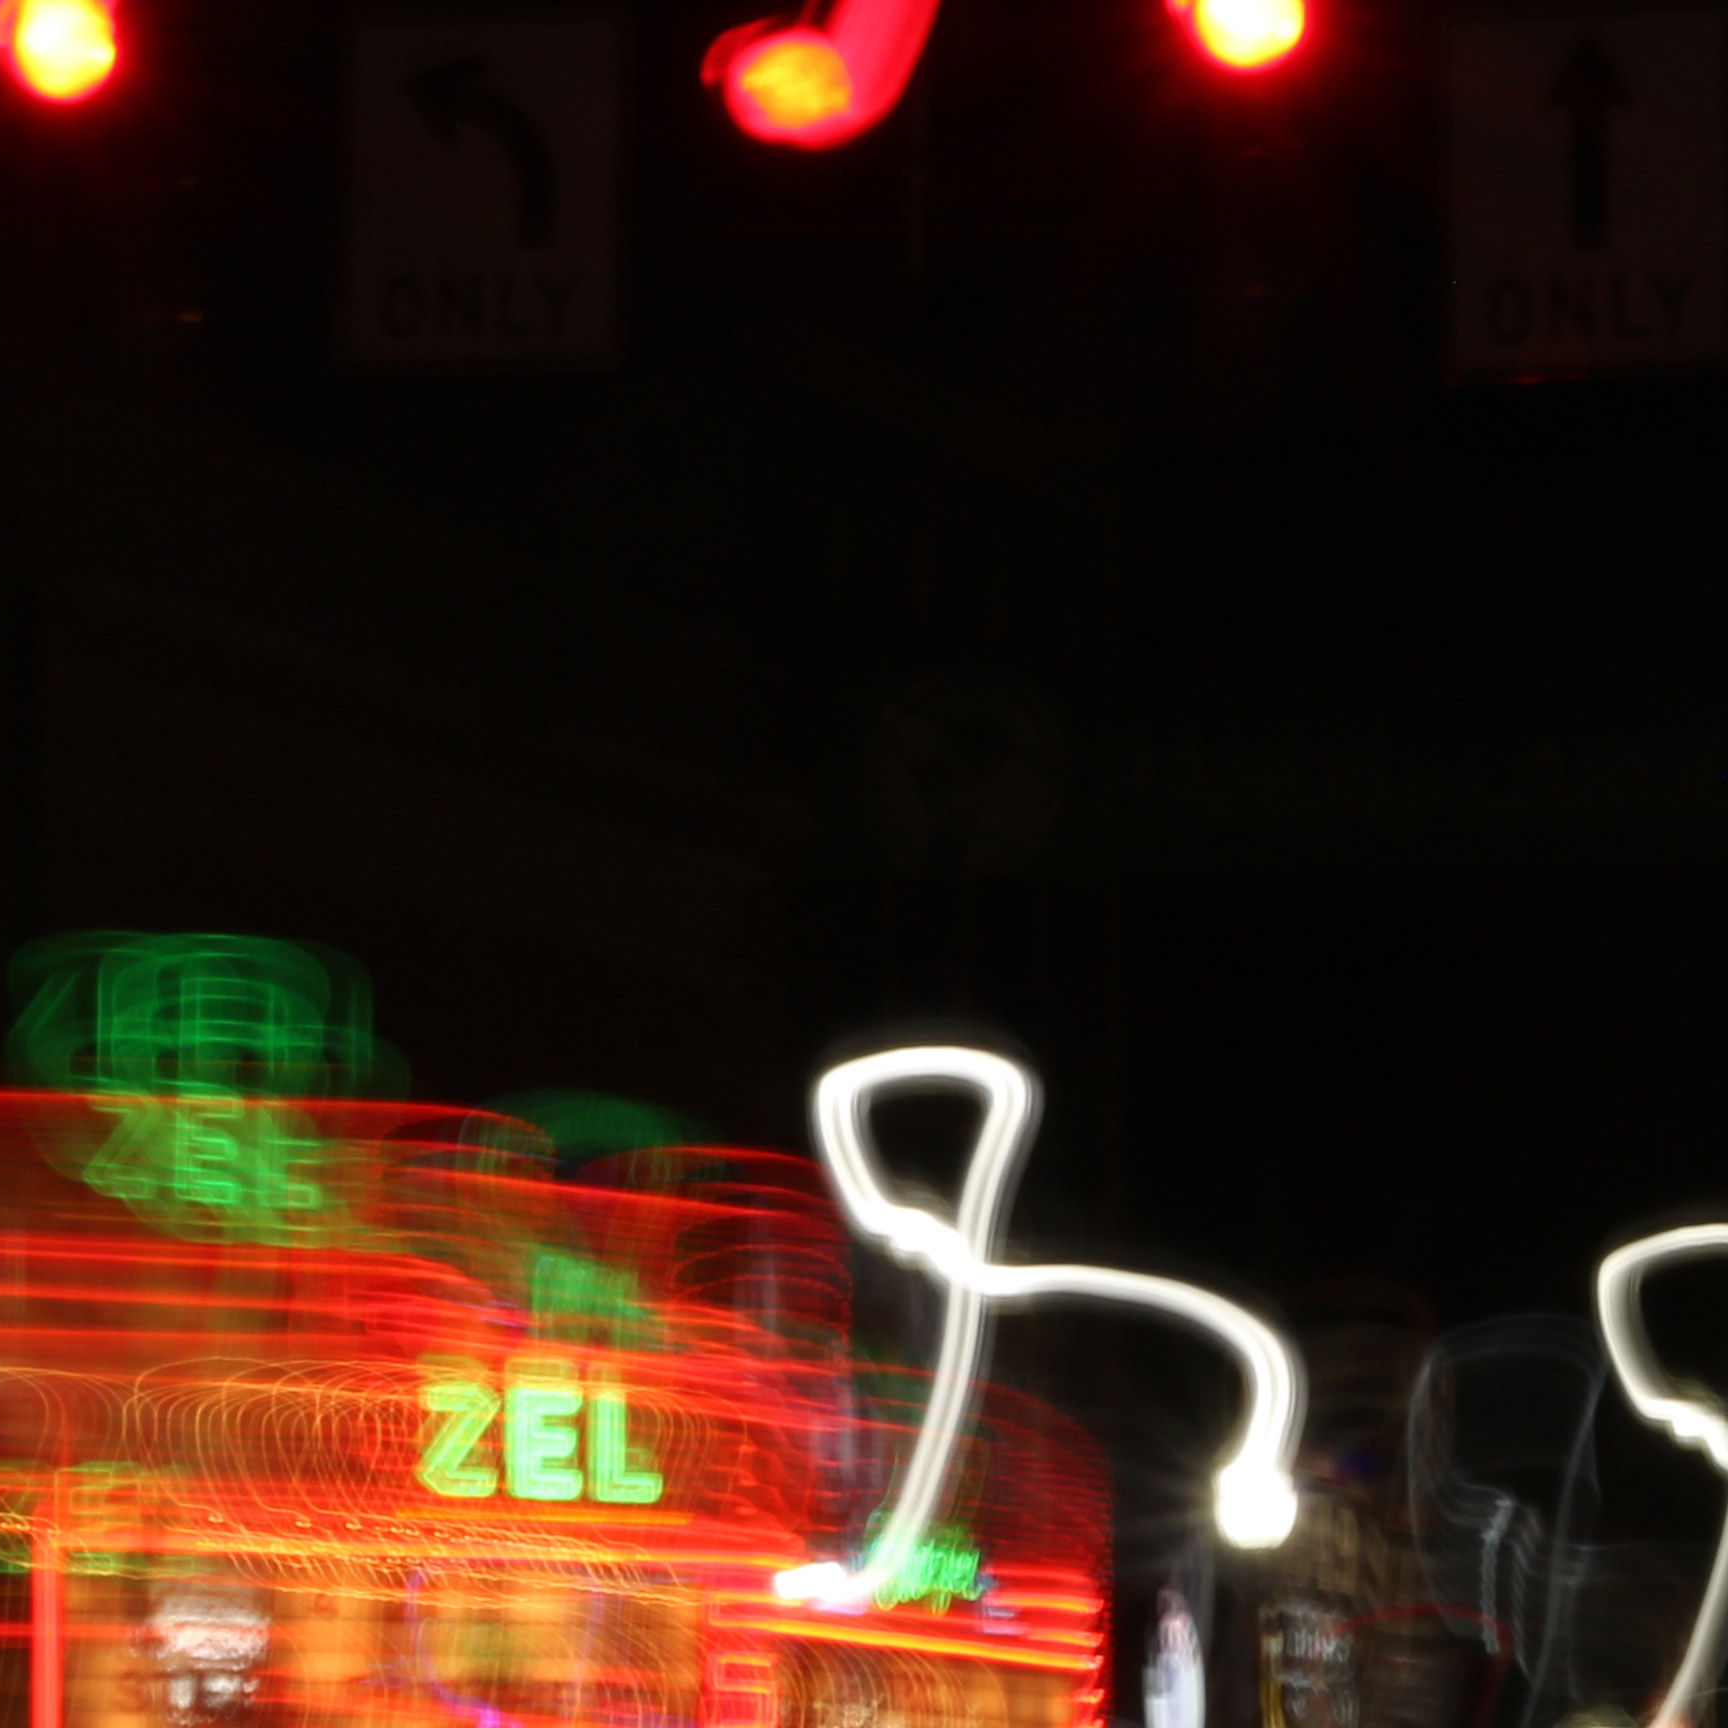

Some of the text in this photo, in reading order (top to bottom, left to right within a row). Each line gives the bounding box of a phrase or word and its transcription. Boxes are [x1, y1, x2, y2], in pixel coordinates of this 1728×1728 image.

[377, 272, 587, 340] ONLY
[1484, 272, 1699, 347] ONLY
[418, 1378, 665, 1504] ZEL
